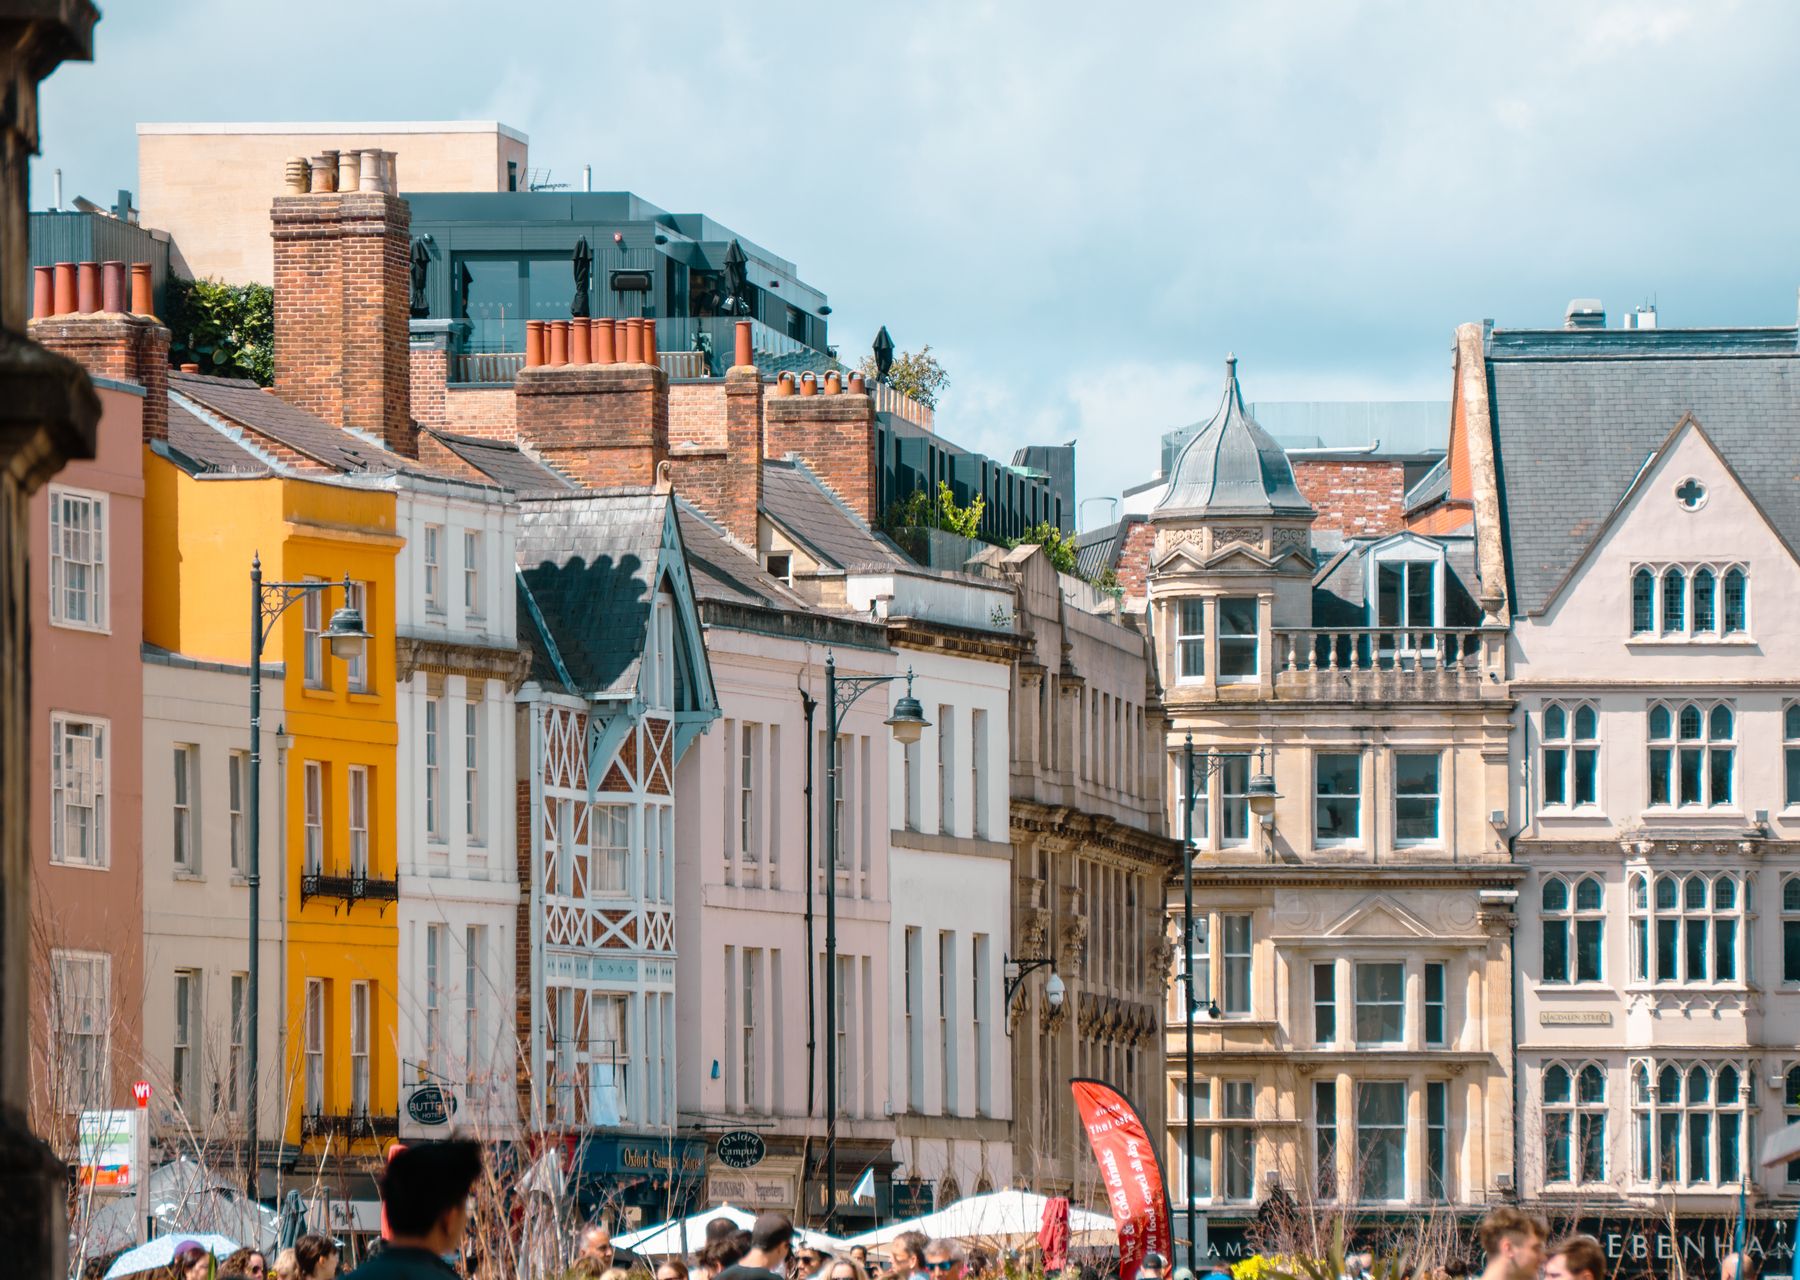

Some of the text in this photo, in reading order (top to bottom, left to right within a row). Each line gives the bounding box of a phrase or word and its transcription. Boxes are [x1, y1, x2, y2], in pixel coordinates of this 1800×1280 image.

[722, 1132, 759, 1146] Oxford
[624, 1147, 649, 1168] Oxford
[720, 1146, 758, 1158] Campus
[1126, 1140, 1139, 1158] day
[1102, 1148, 1122, 1187] drinks
[1113, 1189, 1131, 1220] Cold
[1121, 1223, 1135, 1235] &
[1144, 1208, 1157, 1232] food
